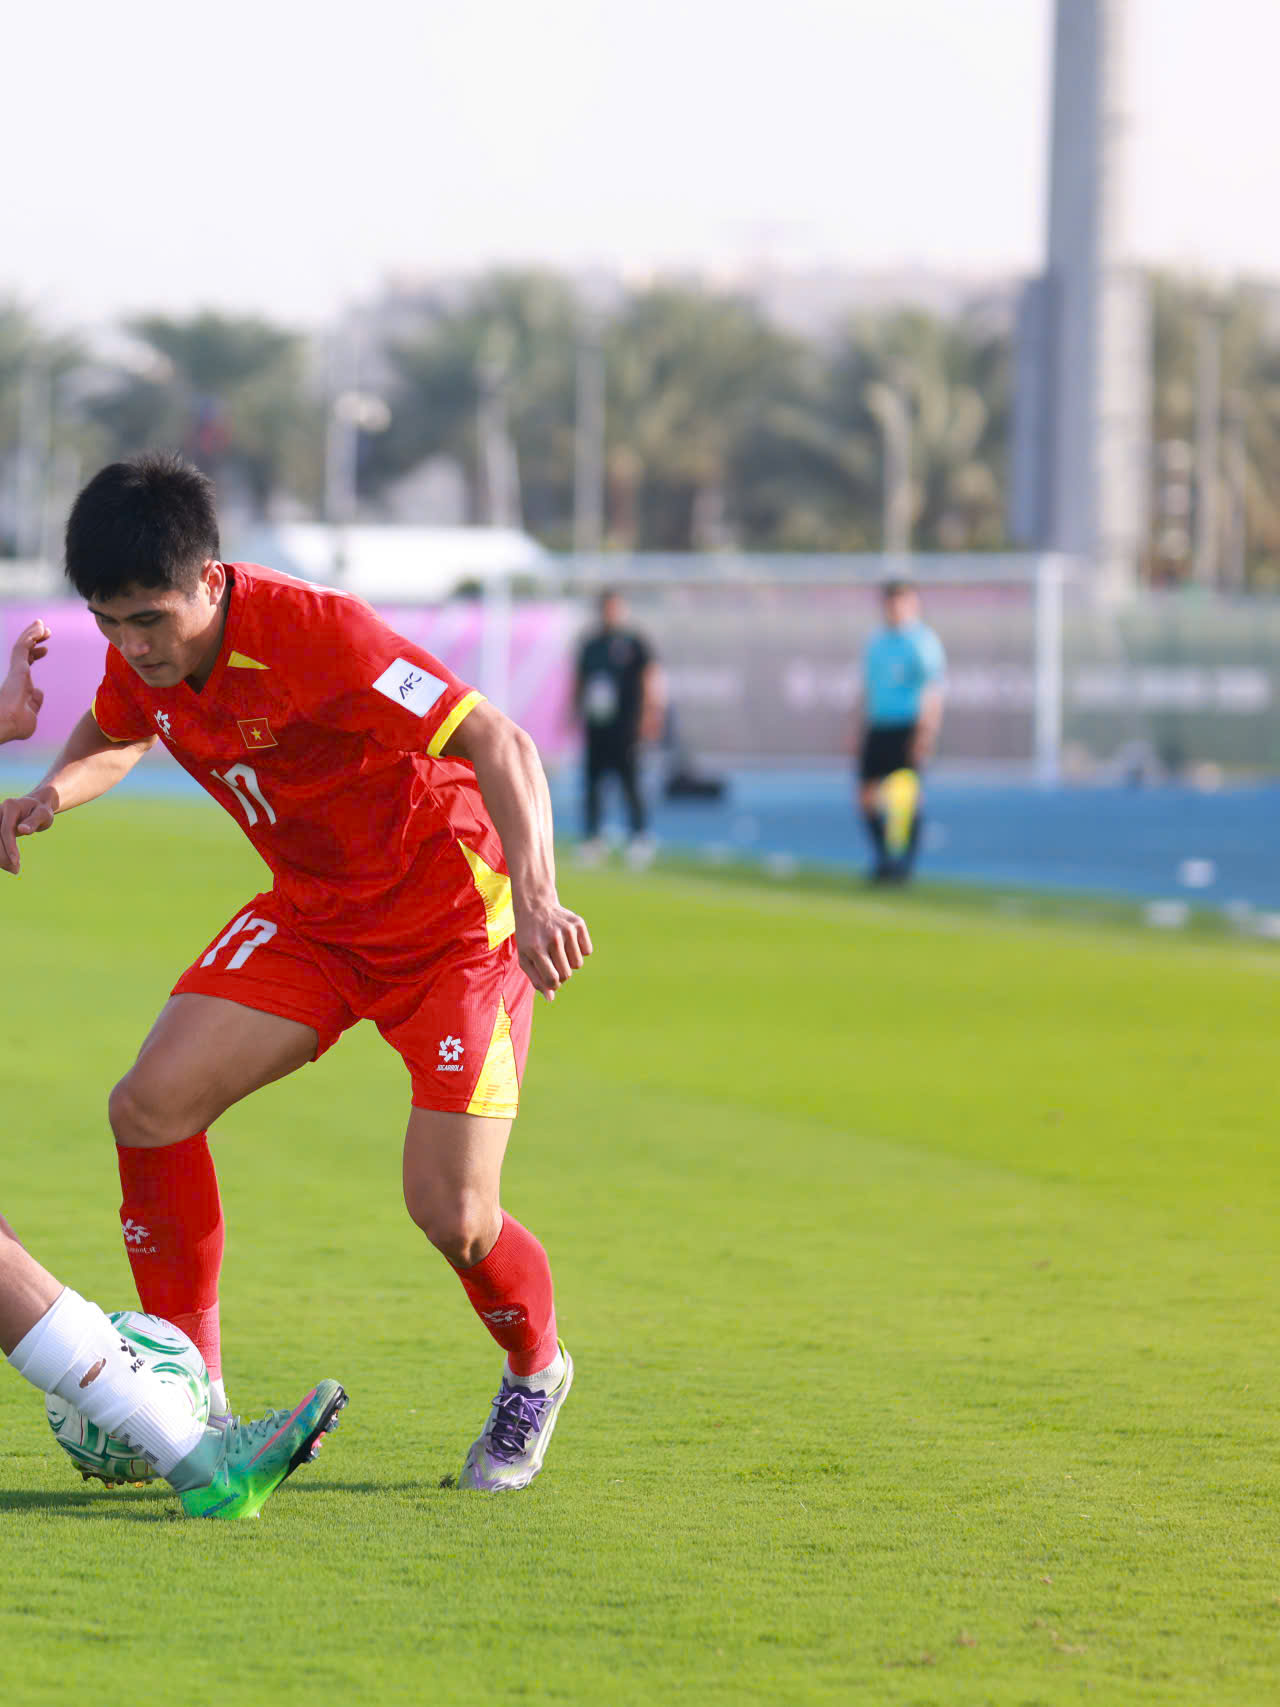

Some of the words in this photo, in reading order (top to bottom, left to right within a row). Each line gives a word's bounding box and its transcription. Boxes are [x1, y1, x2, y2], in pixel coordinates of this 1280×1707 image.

[399, 671, 423, 700] AFC
[210, 763, 277, 827] 17
[200, 909, 277, 970] 17
